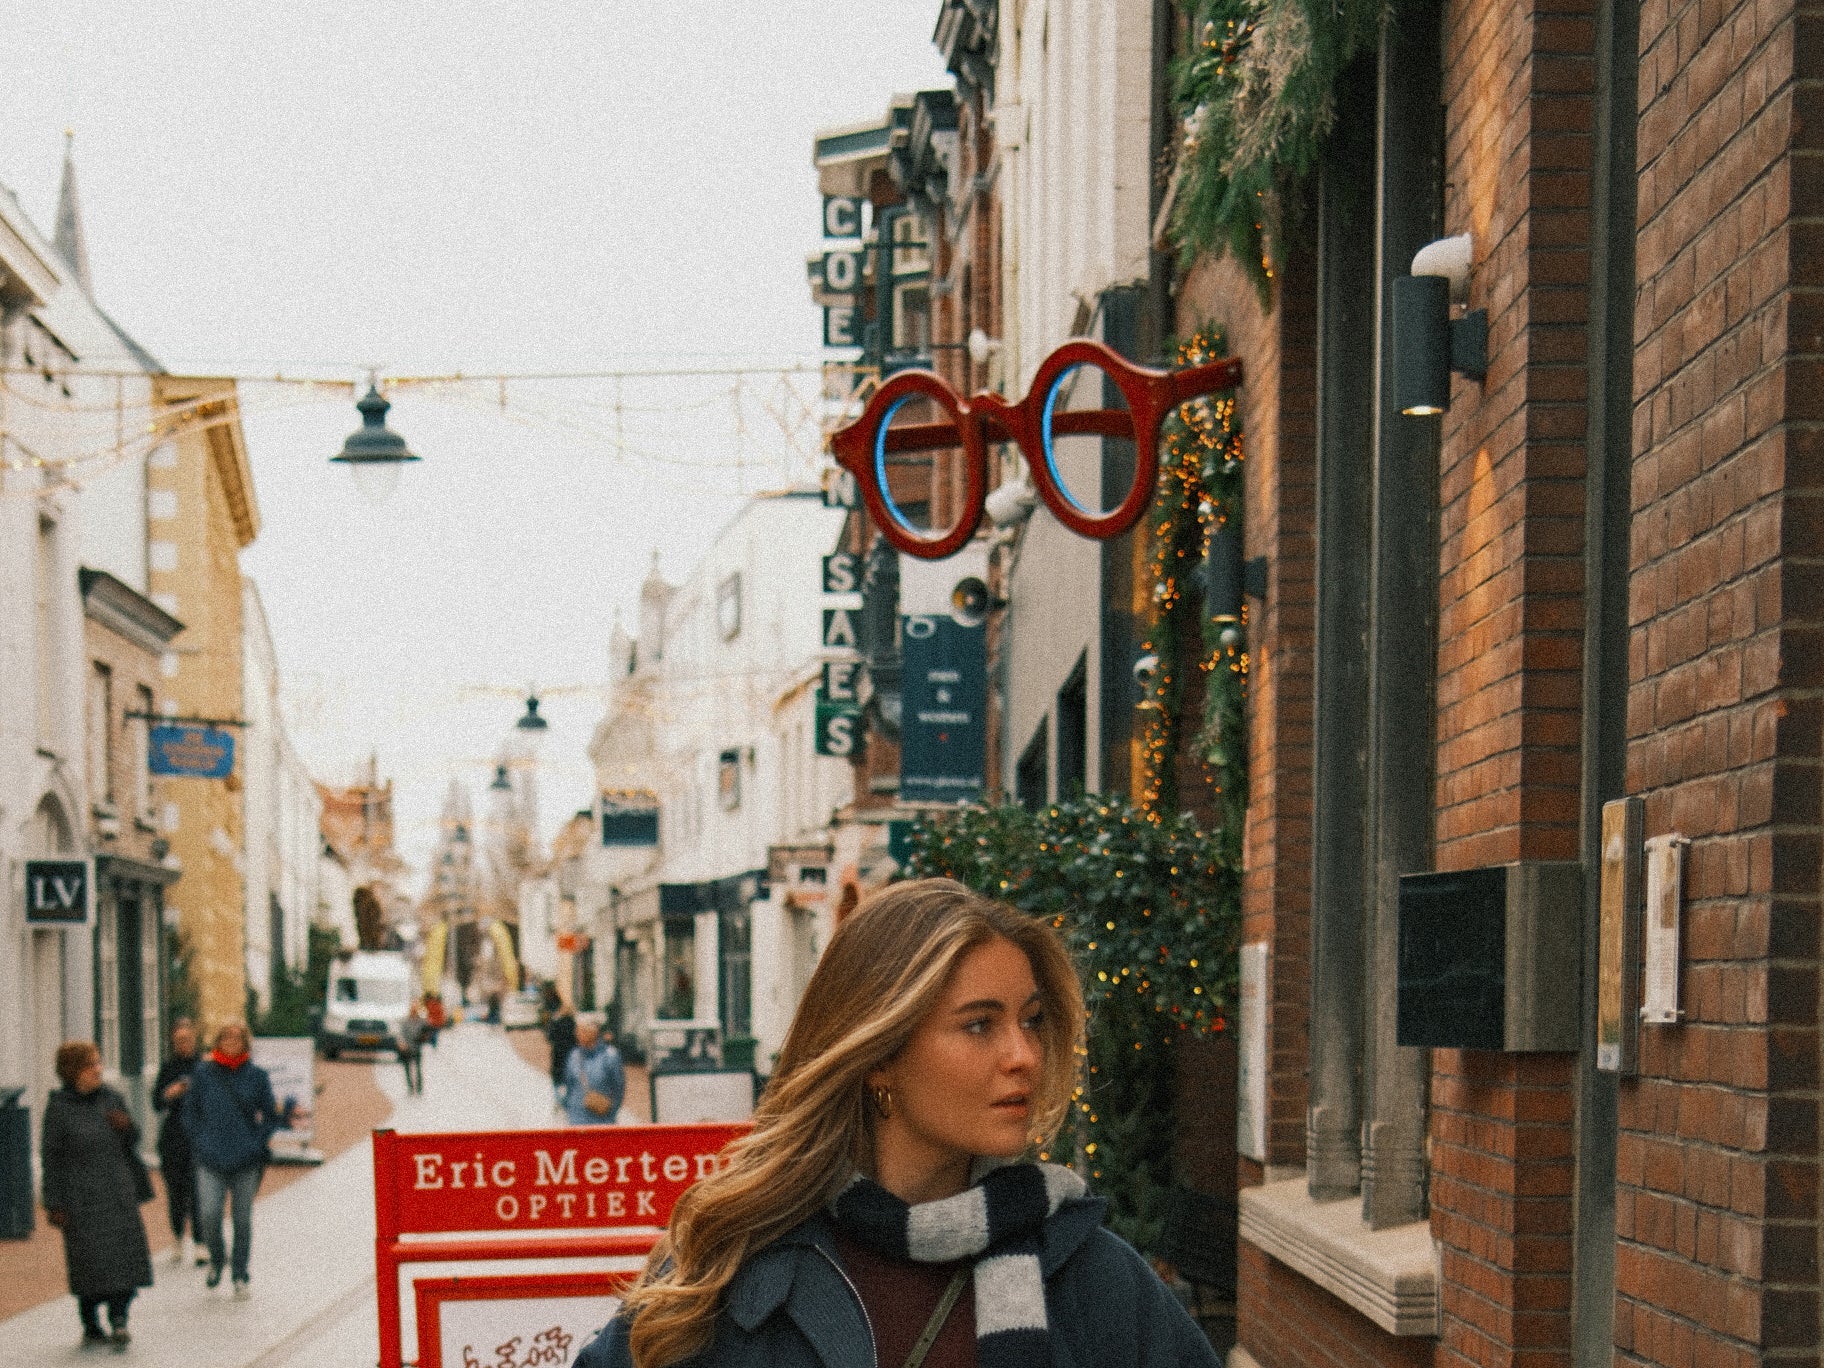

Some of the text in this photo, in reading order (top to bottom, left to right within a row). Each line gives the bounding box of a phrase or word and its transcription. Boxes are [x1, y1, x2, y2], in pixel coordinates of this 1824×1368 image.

[826, 554, 856, 755] SAES
[33, 876, 80, 910] LV
[413, 1153, 517, 1190] Eric
[496, 1191, 657, 1221] OPTIEK
